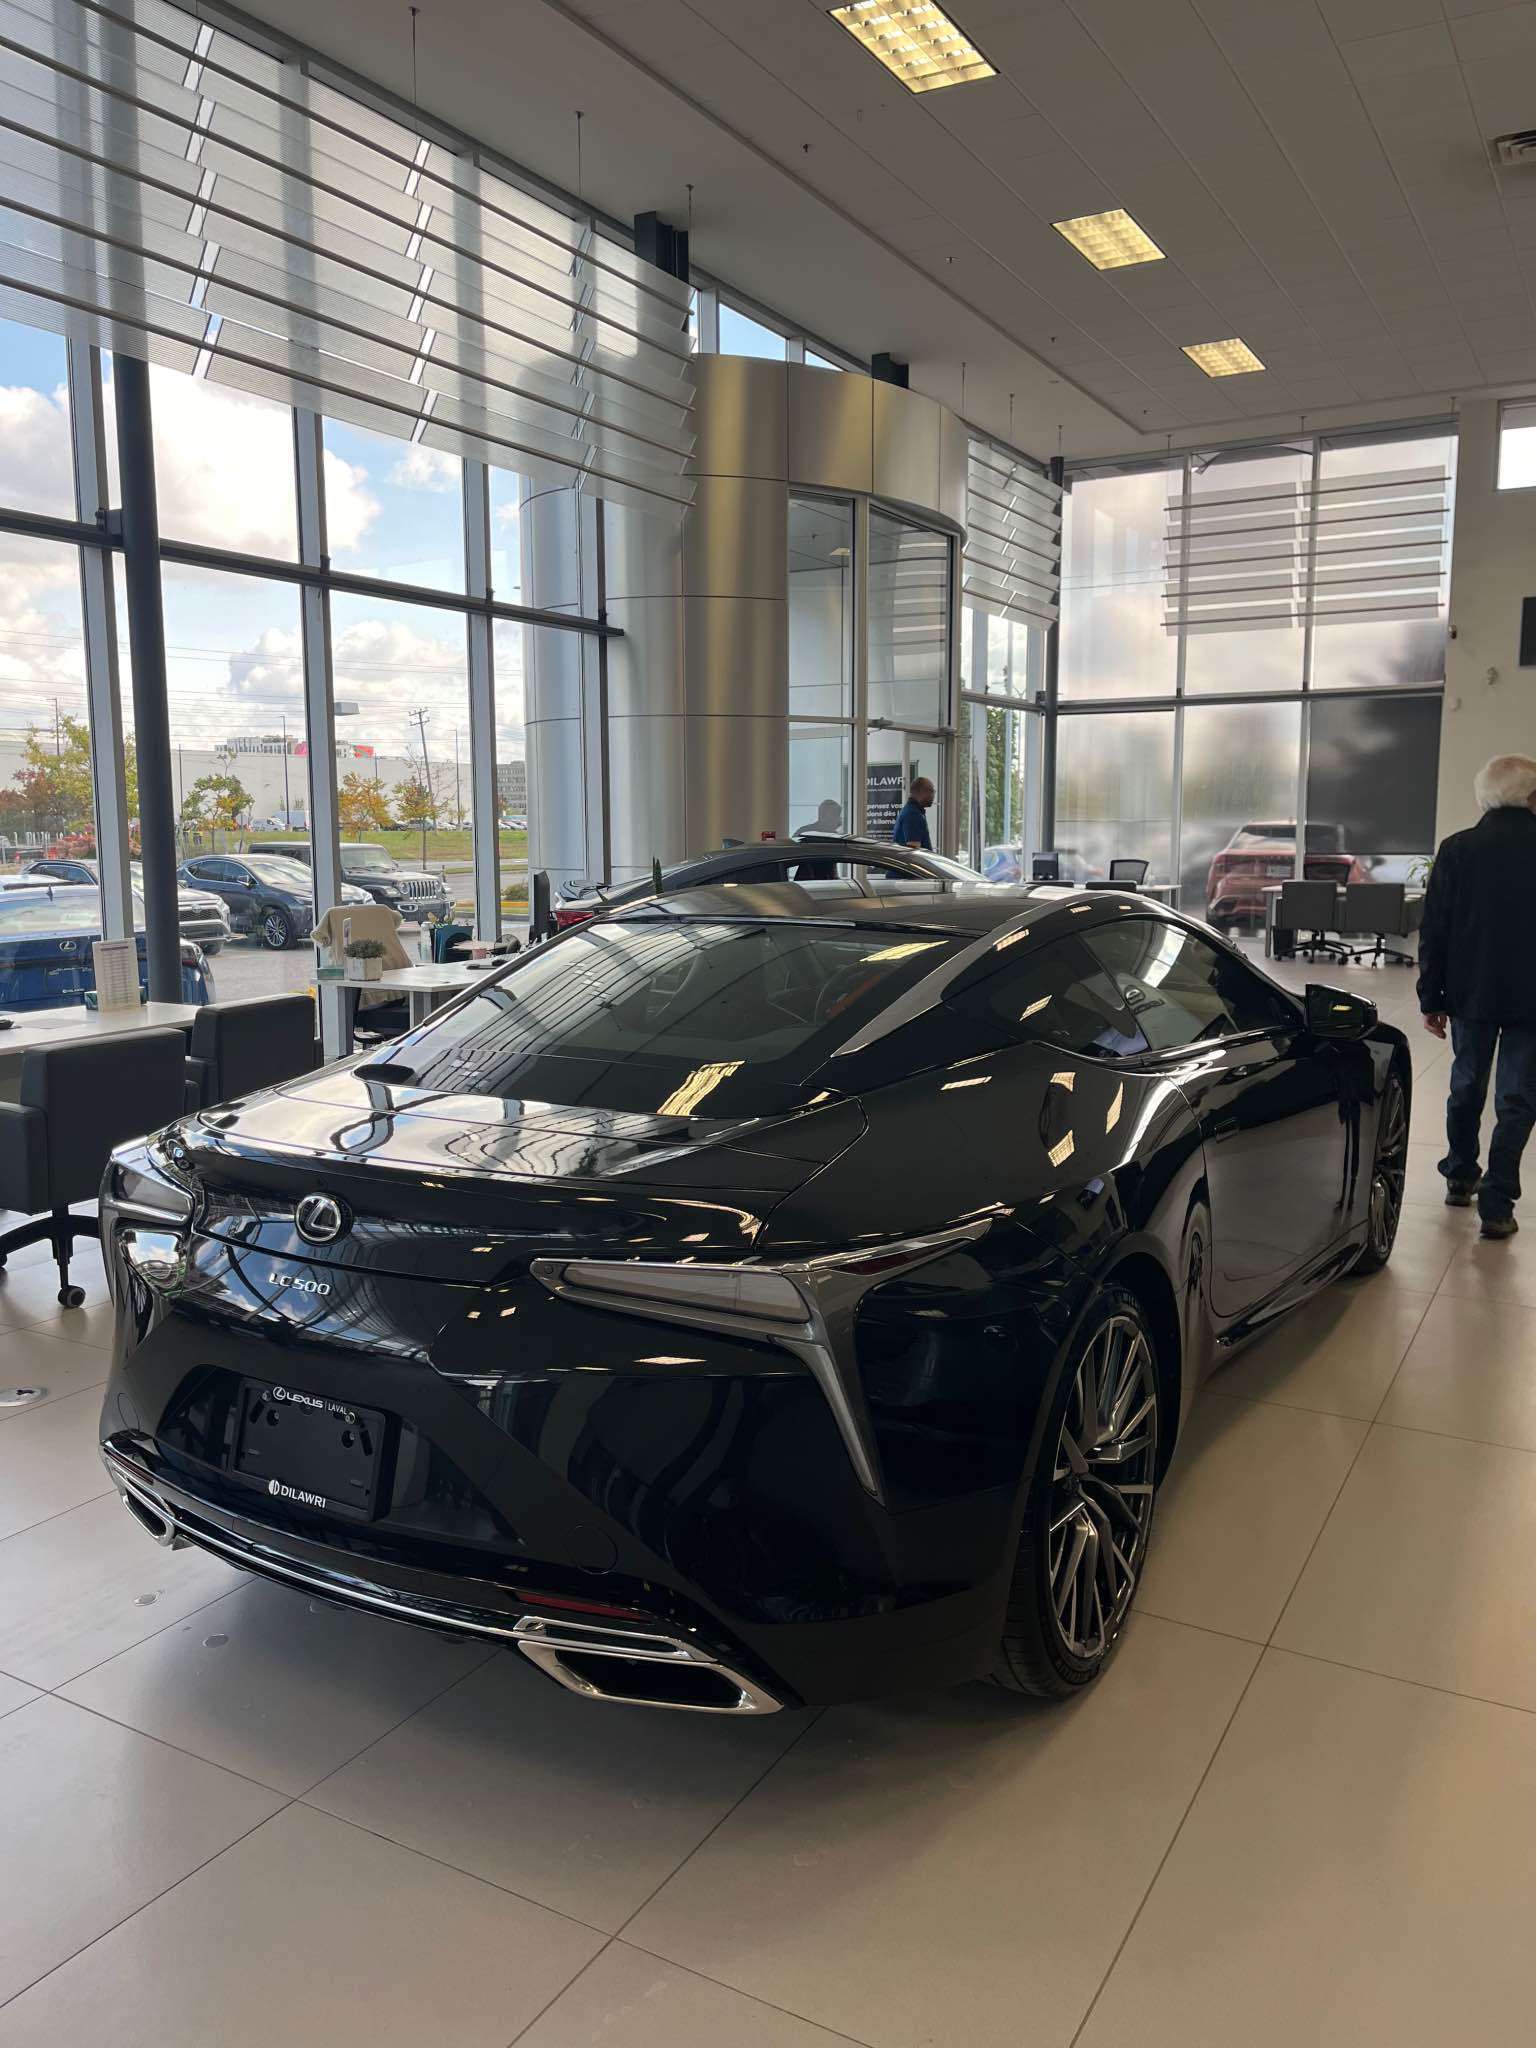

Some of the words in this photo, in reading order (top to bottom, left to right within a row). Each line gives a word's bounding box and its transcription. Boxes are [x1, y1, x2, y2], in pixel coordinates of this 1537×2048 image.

[865, 776, 904, 786] DILAWR
[286, 1391, 324, 1409] LEXUS
[327, 1402, 348, 1415] LAVAL
[280, 1485, 326, 1509] DILAWRI
